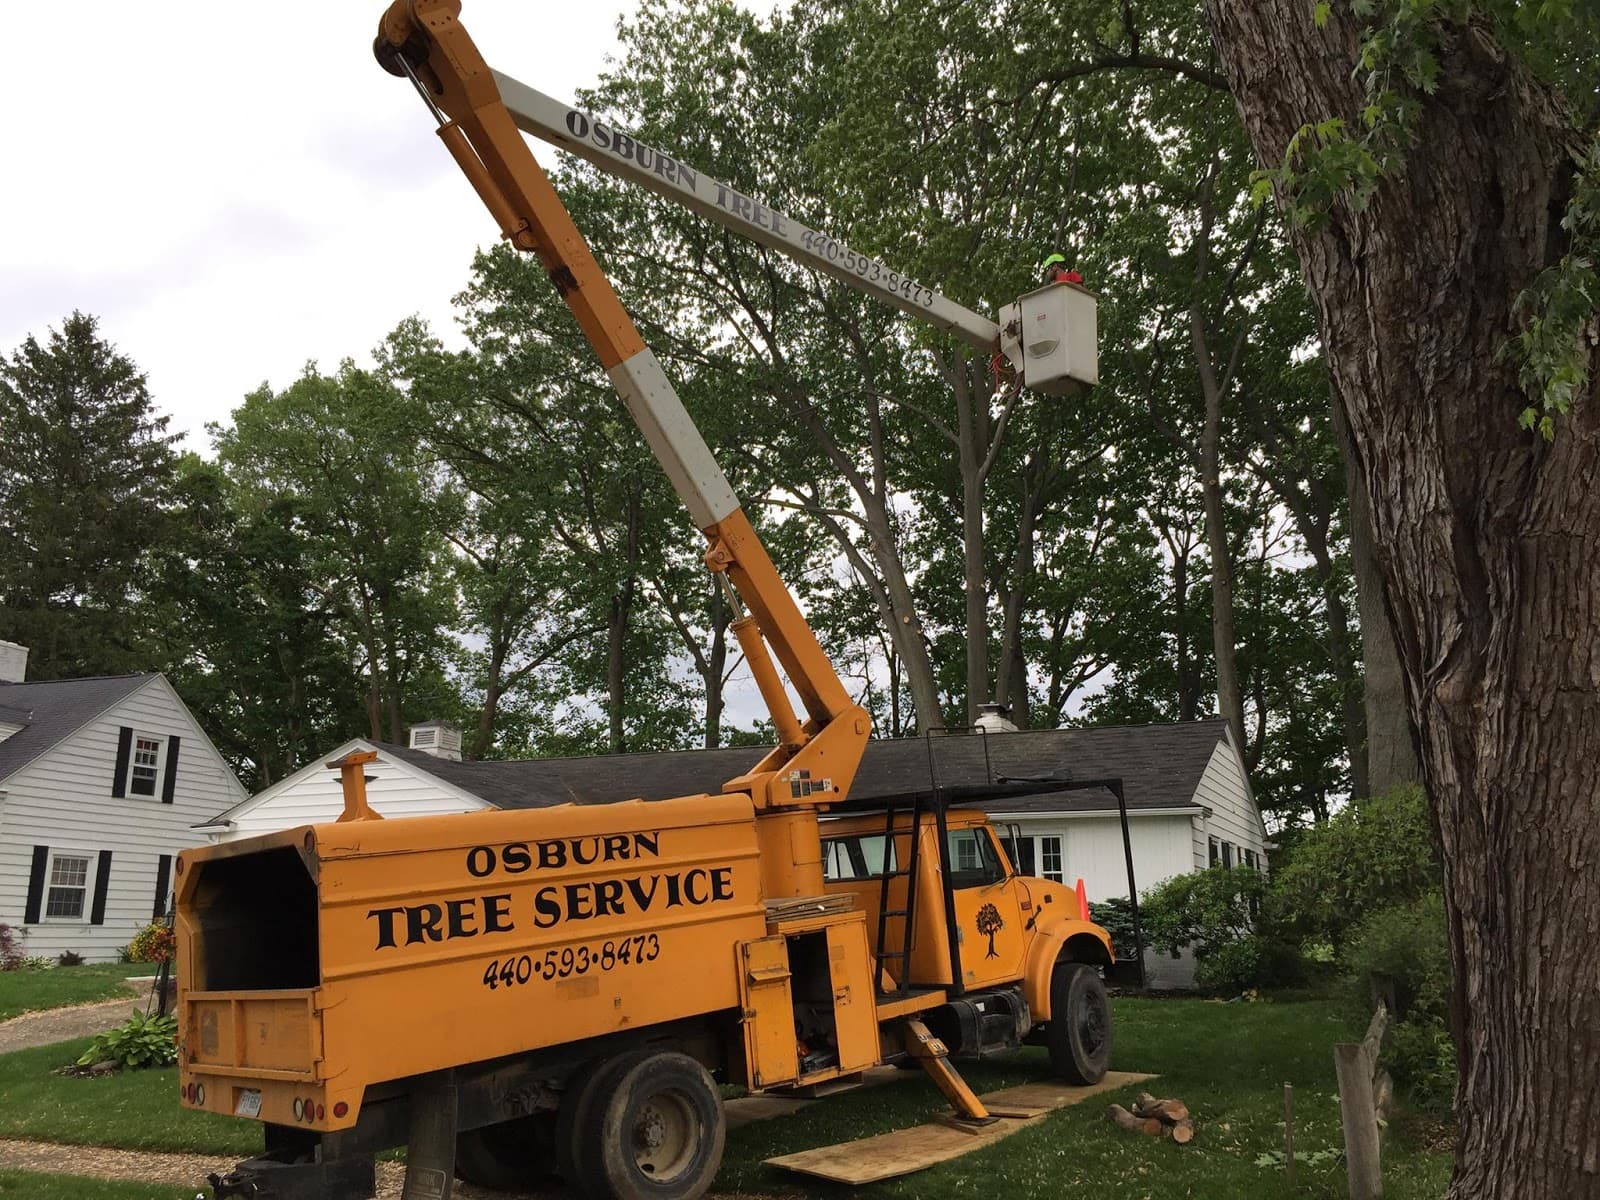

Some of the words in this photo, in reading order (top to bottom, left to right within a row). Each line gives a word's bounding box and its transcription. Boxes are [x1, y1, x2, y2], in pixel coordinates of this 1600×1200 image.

[566, 111, 697, 192] OSBURN
[713, 183, 787, 236] TREE
[466, 832, 659, 877] OSBURN
[367, 893, 515, 950] TREE
[534, 867, 734, 928] SERVICE
